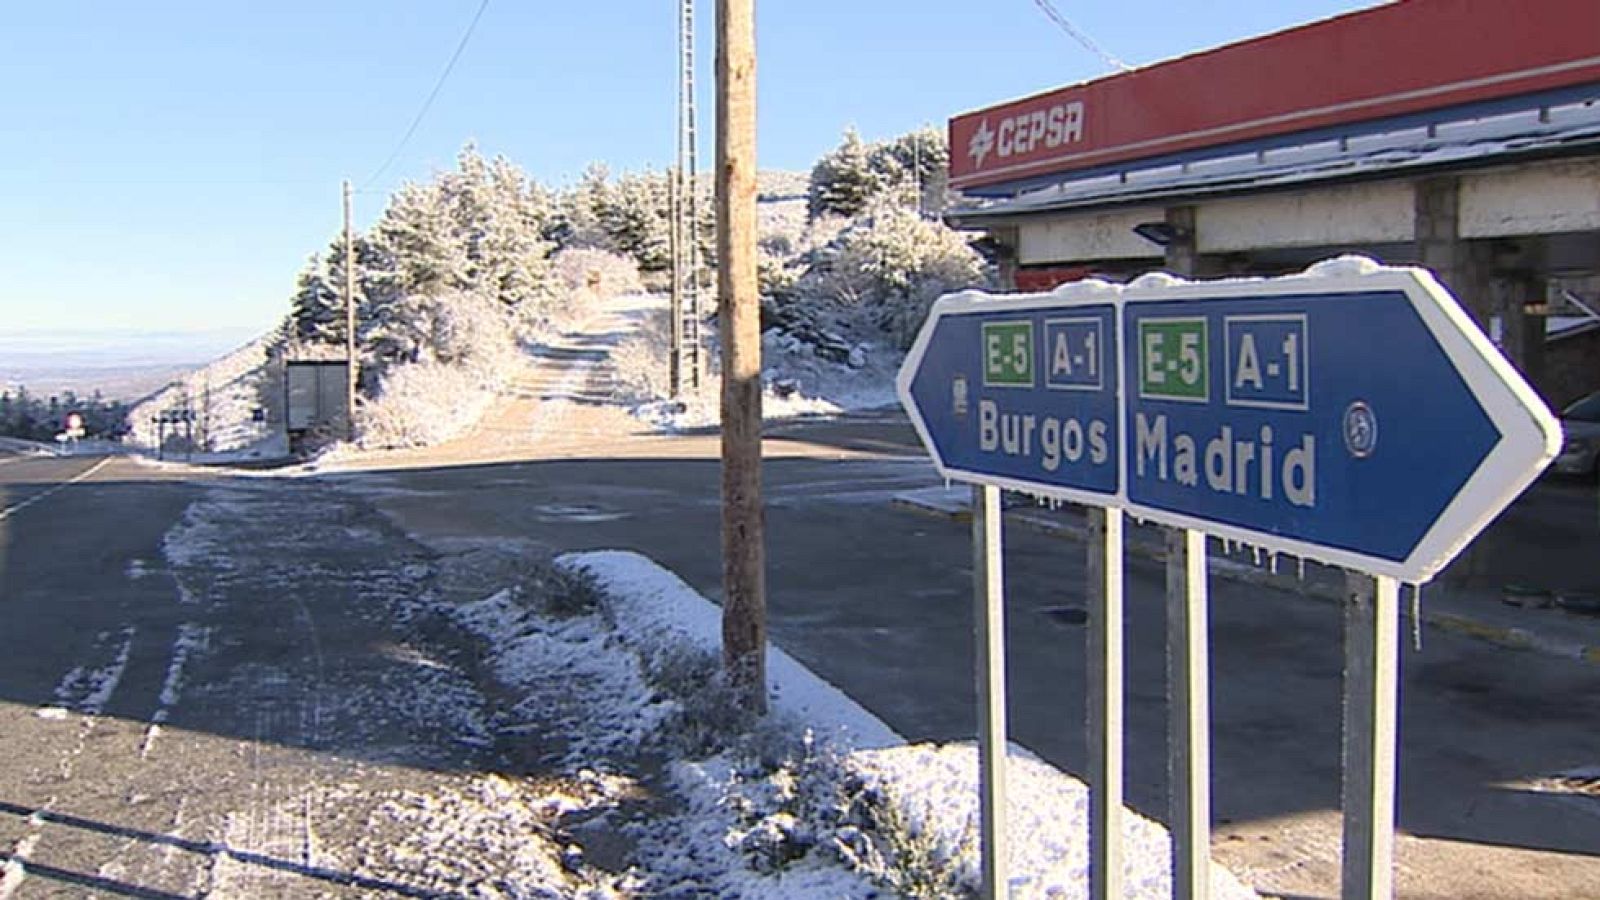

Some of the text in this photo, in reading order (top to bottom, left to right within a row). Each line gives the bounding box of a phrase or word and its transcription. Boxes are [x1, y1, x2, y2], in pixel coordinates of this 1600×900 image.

[997, 102, 1084, 157] CEPSA
[988, 331, 1096, 376] E-5 A-1
[1146, 332, 1298, 391] E-5 A-1
[979, 399, 1108, 471] Burgos
[1135, 412, 1316, 507] Madrid
